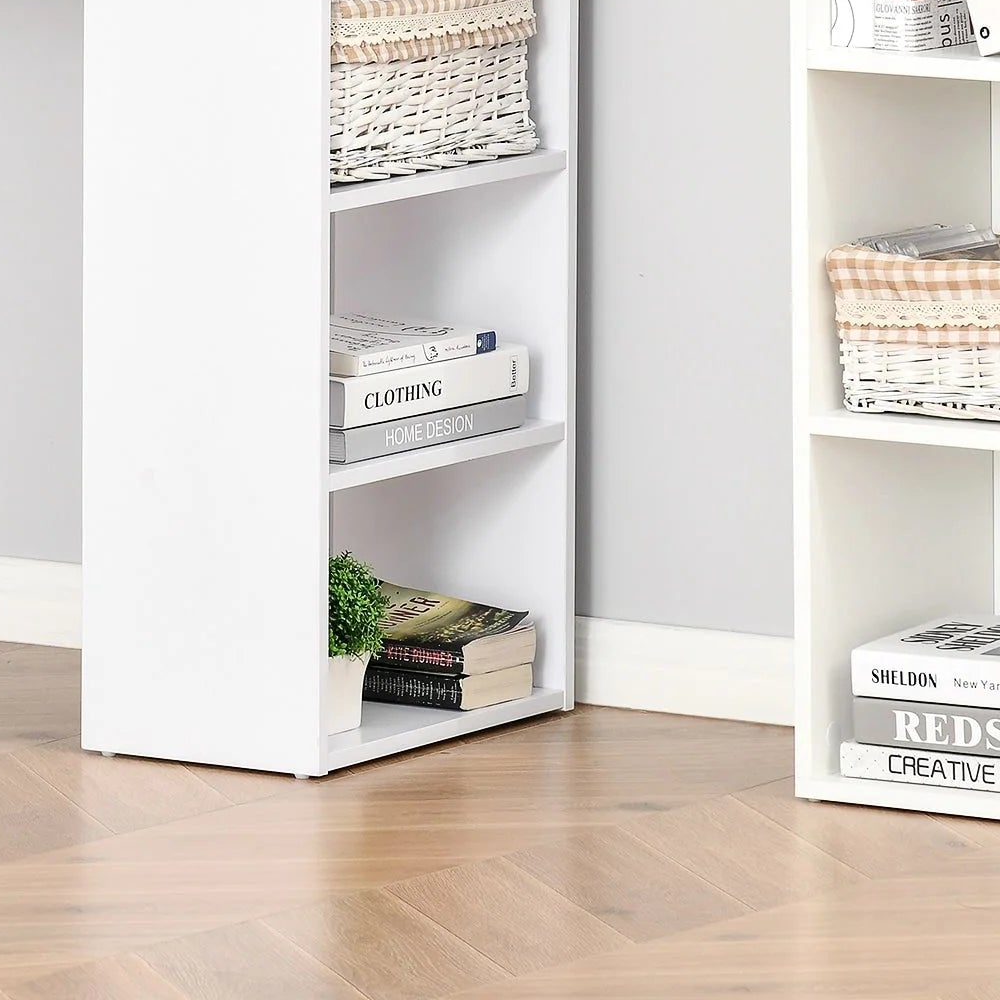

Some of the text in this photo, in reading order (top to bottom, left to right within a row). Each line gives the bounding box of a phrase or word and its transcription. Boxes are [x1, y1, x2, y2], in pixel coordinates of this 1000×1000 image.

[364, 380, 442, 410] CLOTHING
[385, 423, 423, 447] HOME
[377, 597, 440, 629] UNNER
[871, 668, 937, 689] SHELDON
[953, 678, 978, 689] New
[888, 754, 996, 785] CREATIVE
